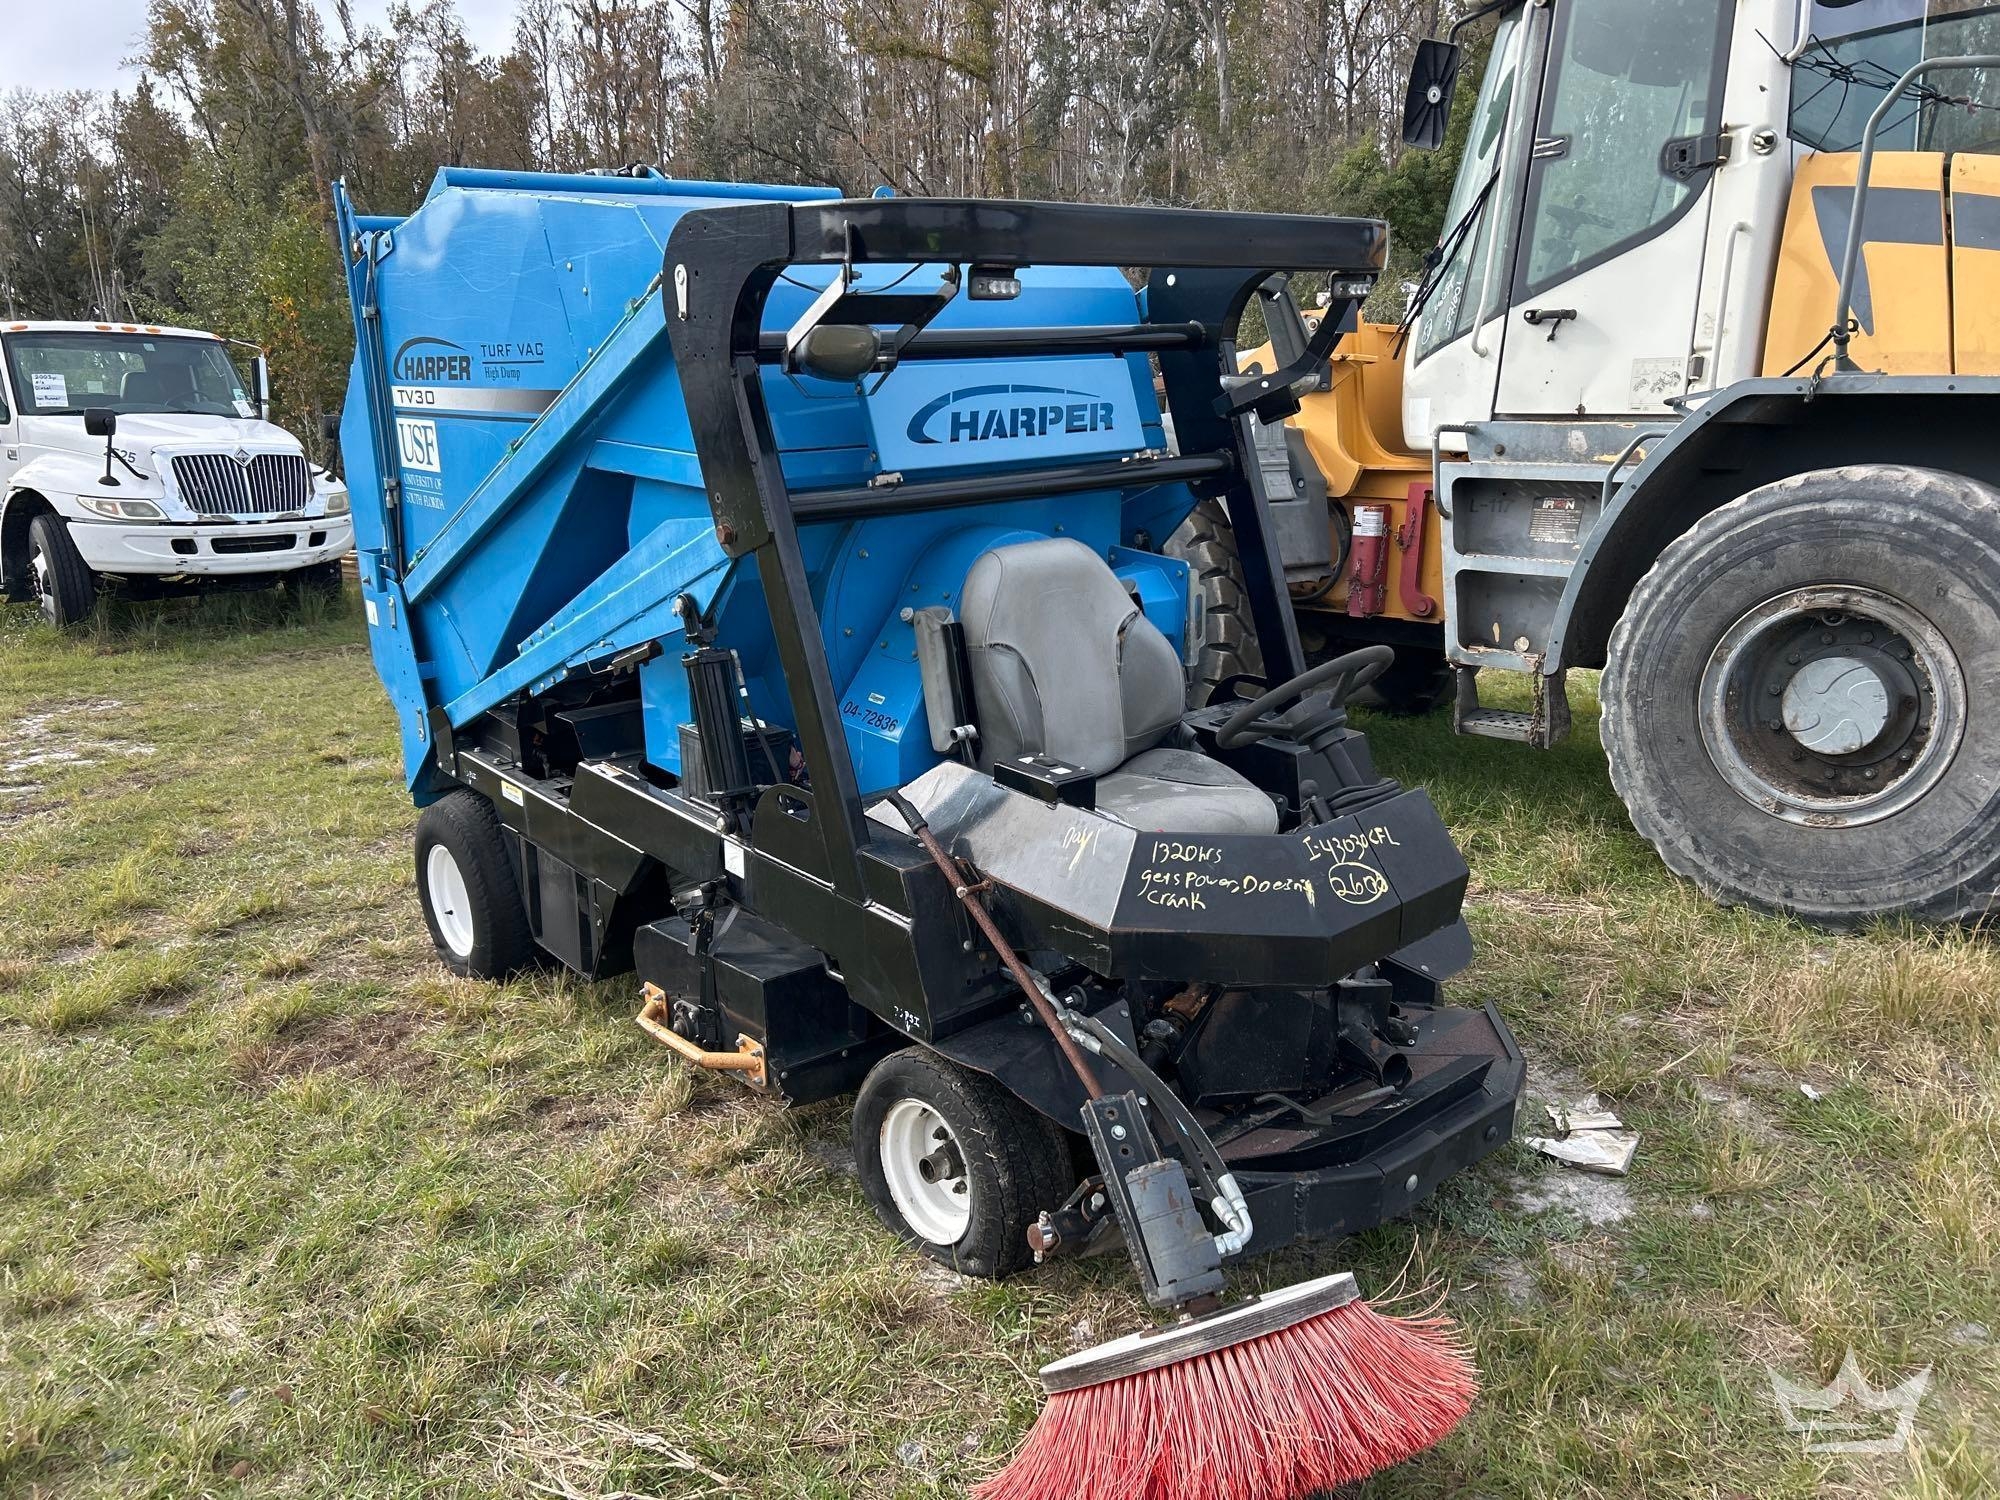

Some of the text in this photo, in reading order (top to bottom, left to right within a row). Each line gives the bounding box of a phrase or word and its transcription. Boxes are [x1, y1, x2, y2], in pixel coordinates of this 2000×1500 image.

[404, 343, 544, 381] HARPER TURF VAC
[485, 366, 521, 381] High Dump
[397, 389, 435, 404] TV30
[950, 402, 1114, 443] HARPER
[399, 424, 435, 467] USF
[404, 473, 442, 490] UNIVERSITY OF
[406, 492, 446, 511] SOUTH FLORIDA
[843, 701, 899, 732] 04-72836
